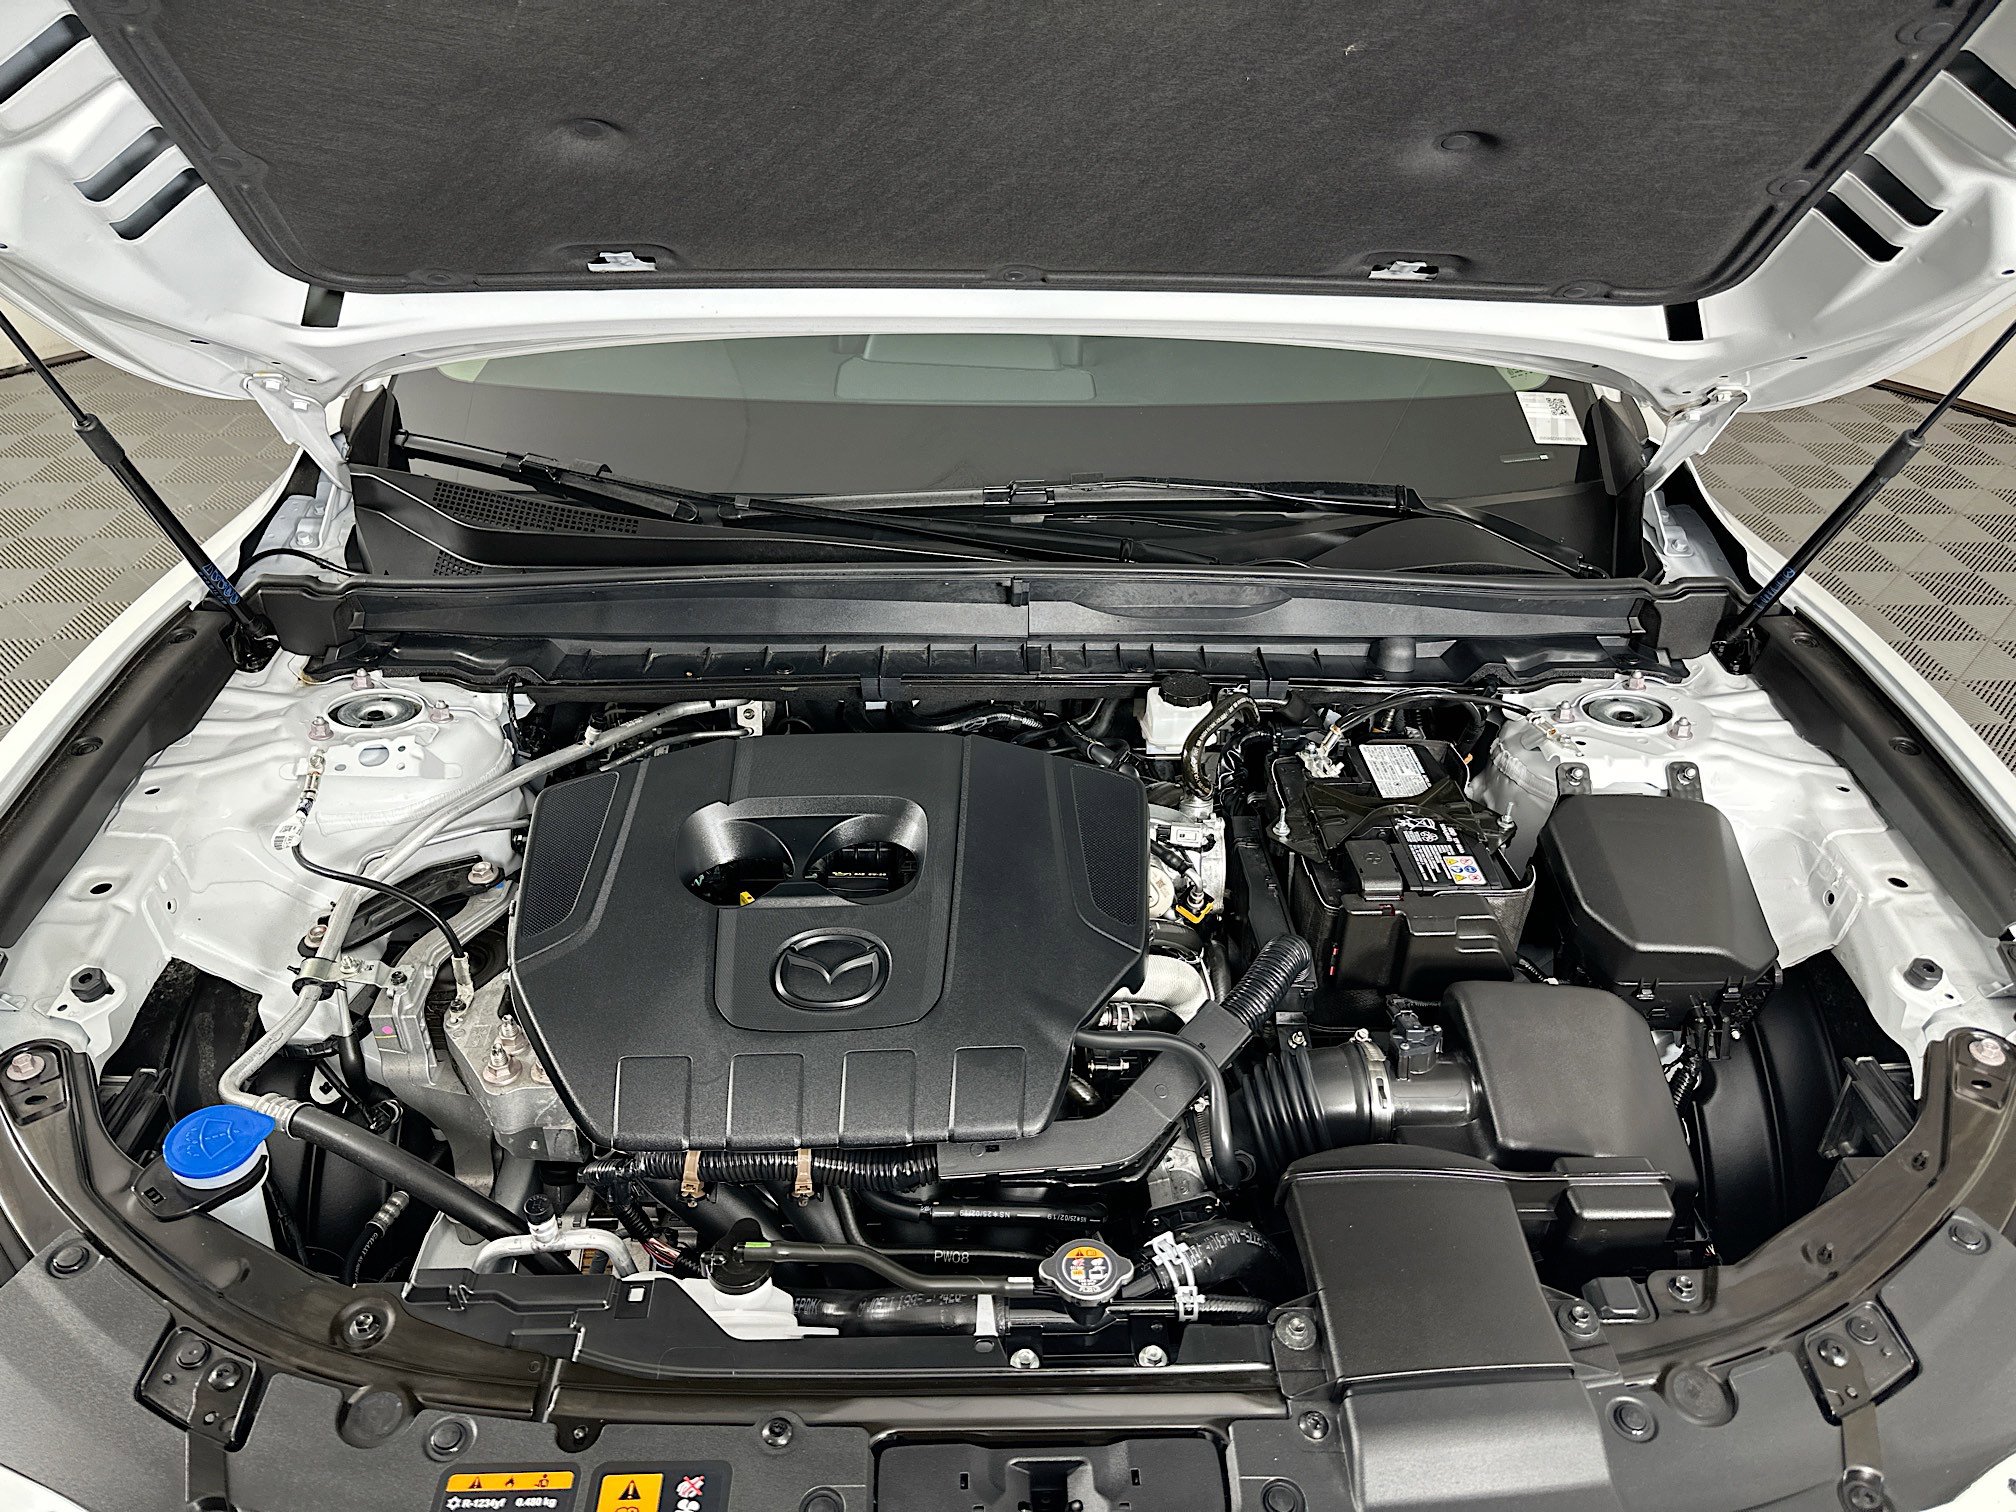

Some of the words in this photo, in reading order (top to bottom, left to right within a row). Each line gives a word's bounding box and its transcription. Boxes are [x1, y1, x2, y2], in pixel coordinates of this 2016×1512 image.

[934, 1249, 970, 1264] PW08
[461, 1497, 507, 1510] R-1234yf
[543, 1496, 558, 1509] kg
